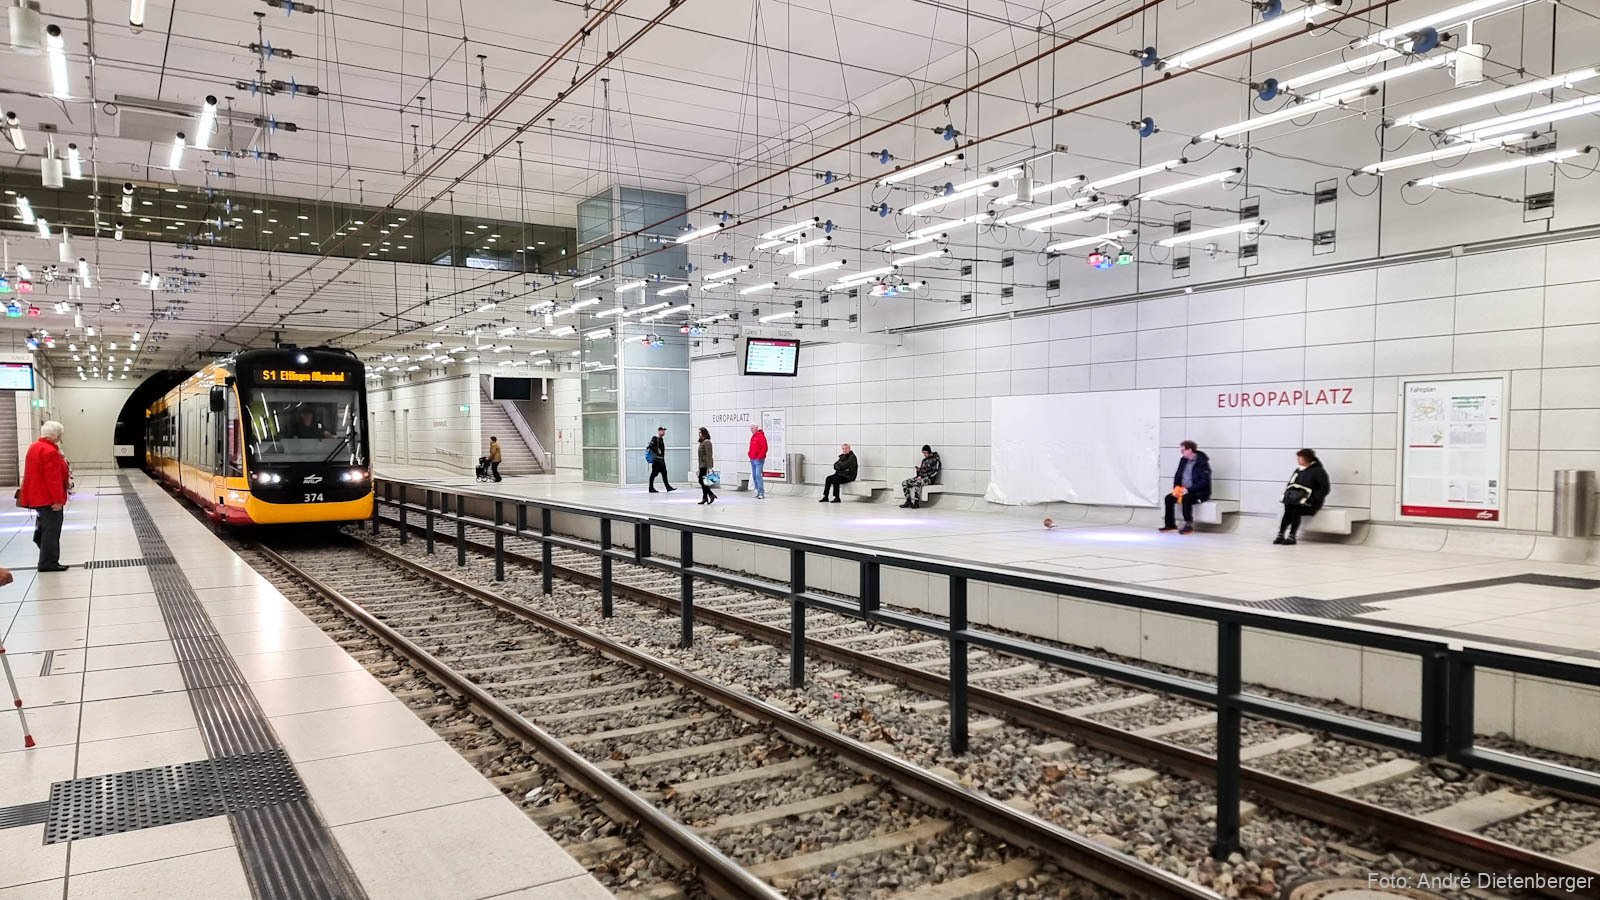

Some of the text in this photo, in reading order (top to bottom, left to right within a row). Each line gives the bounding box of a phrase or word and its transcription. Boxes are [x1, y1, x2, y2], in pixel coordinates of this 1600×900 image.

[262, 370, 276, 380] S1
[1217, 388, 1353, 408] EUROPAPLATZ
[712, 413, 750, 423] EUROPAPLATZ
[304, 493, 324, 503] 374
